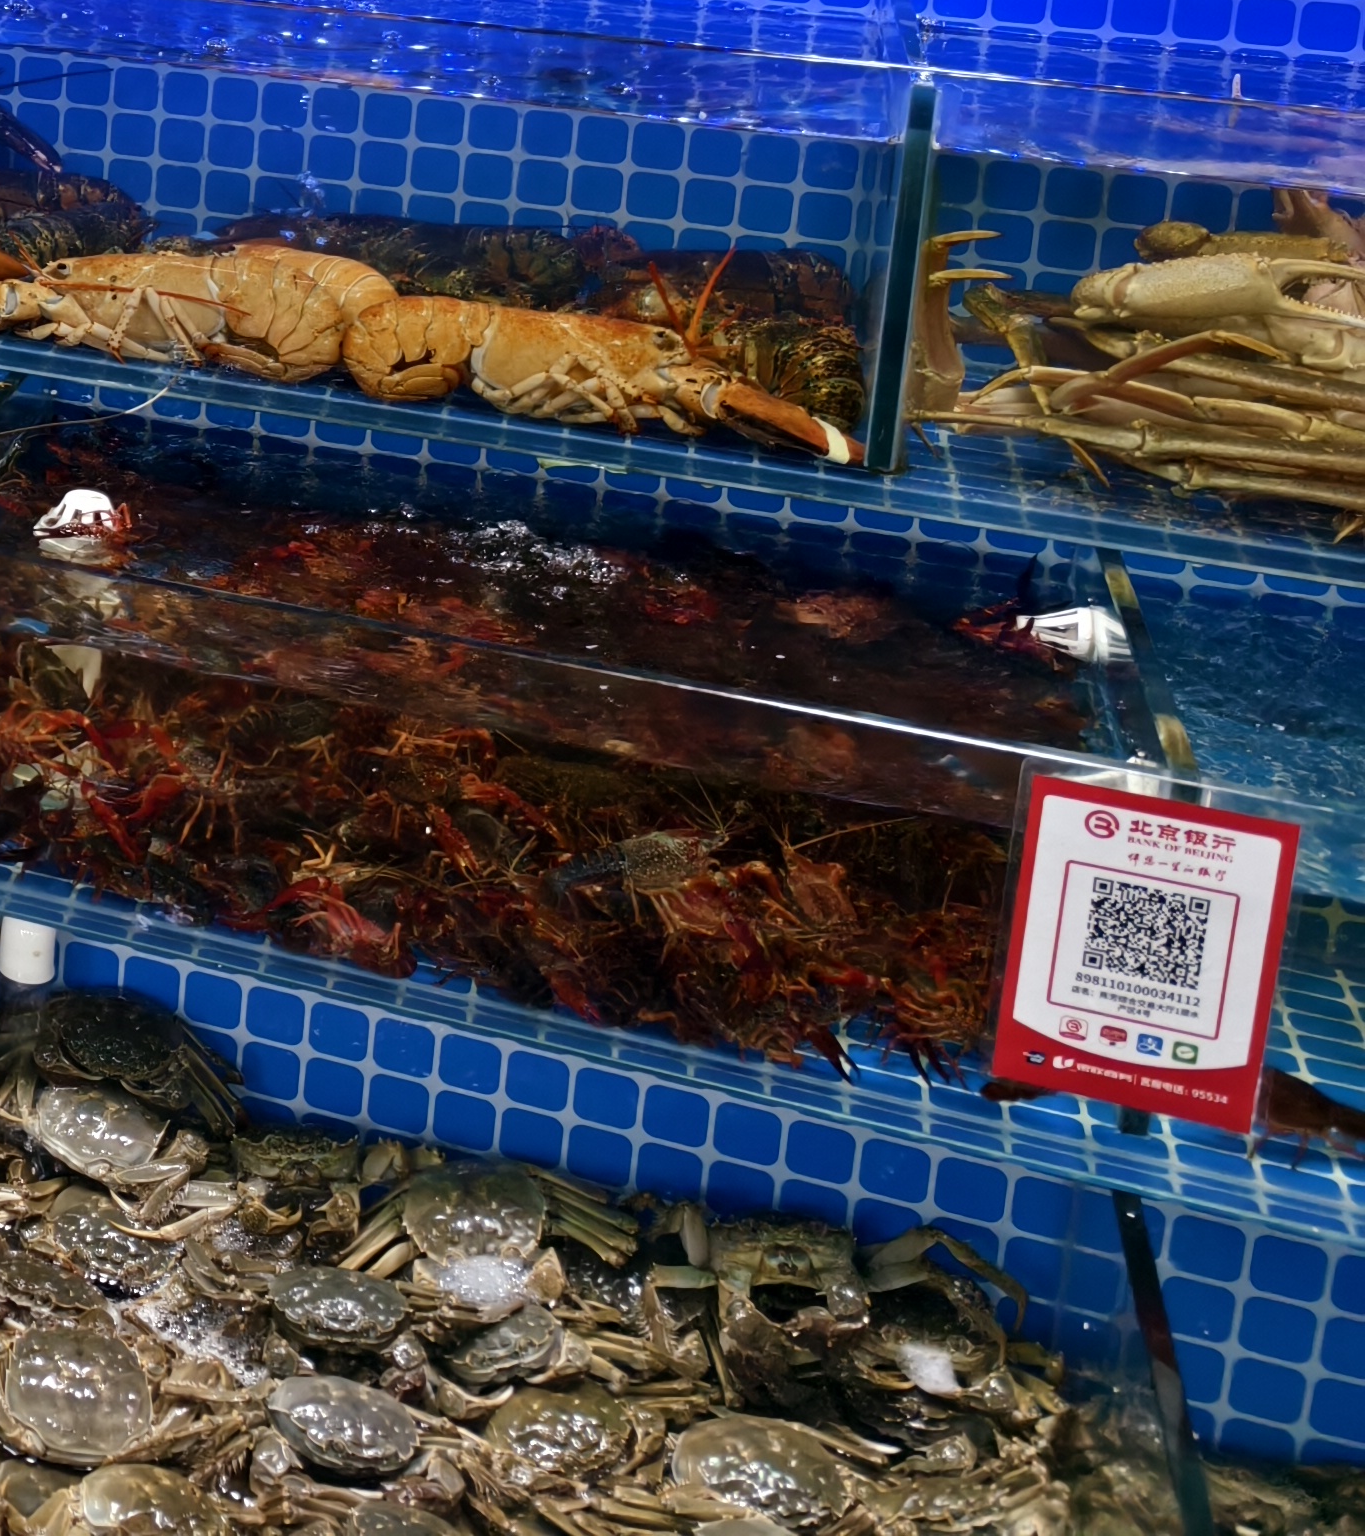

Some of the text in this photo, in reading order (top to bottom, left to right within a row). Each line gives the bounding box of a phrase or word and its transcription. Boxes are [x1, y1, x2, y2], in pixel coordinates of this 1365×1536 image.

[1127, 835, 1234, 864] BANK OF BEIJING
[1129, 819, 1237, 853] 北京银行
[1075, 971, 1201, 1007] 898110100034112
